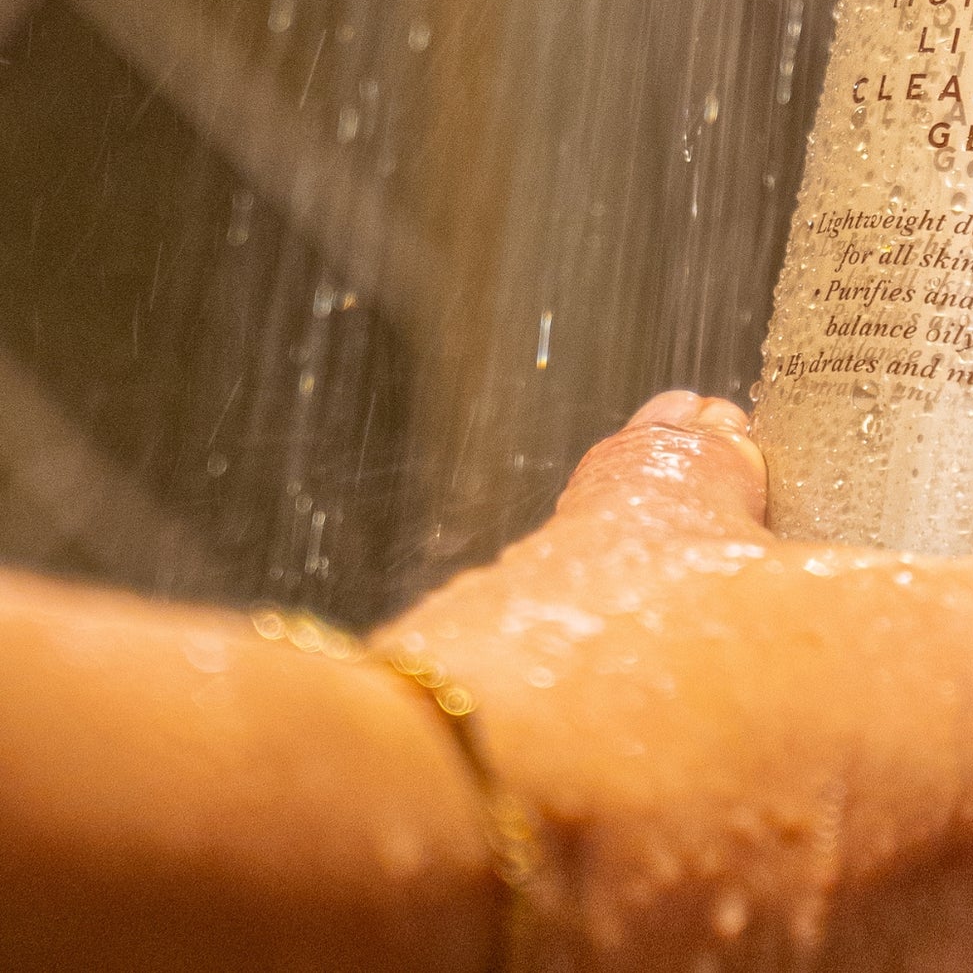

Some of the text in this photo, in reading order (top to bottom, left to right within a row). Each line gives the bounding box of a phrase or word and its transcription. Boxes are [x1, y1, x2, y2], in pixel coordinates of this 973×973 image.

[816, 208, 947, 239] Lightweight
[834, 243, 874, 273] for
[878, 244, 914, 266] all
[824, 279, 917, 308] Purifies
[825, 315, 918, 340] balance
[785, 351, 879, 382] Hydrates
[886, 357, 942, 379] and
